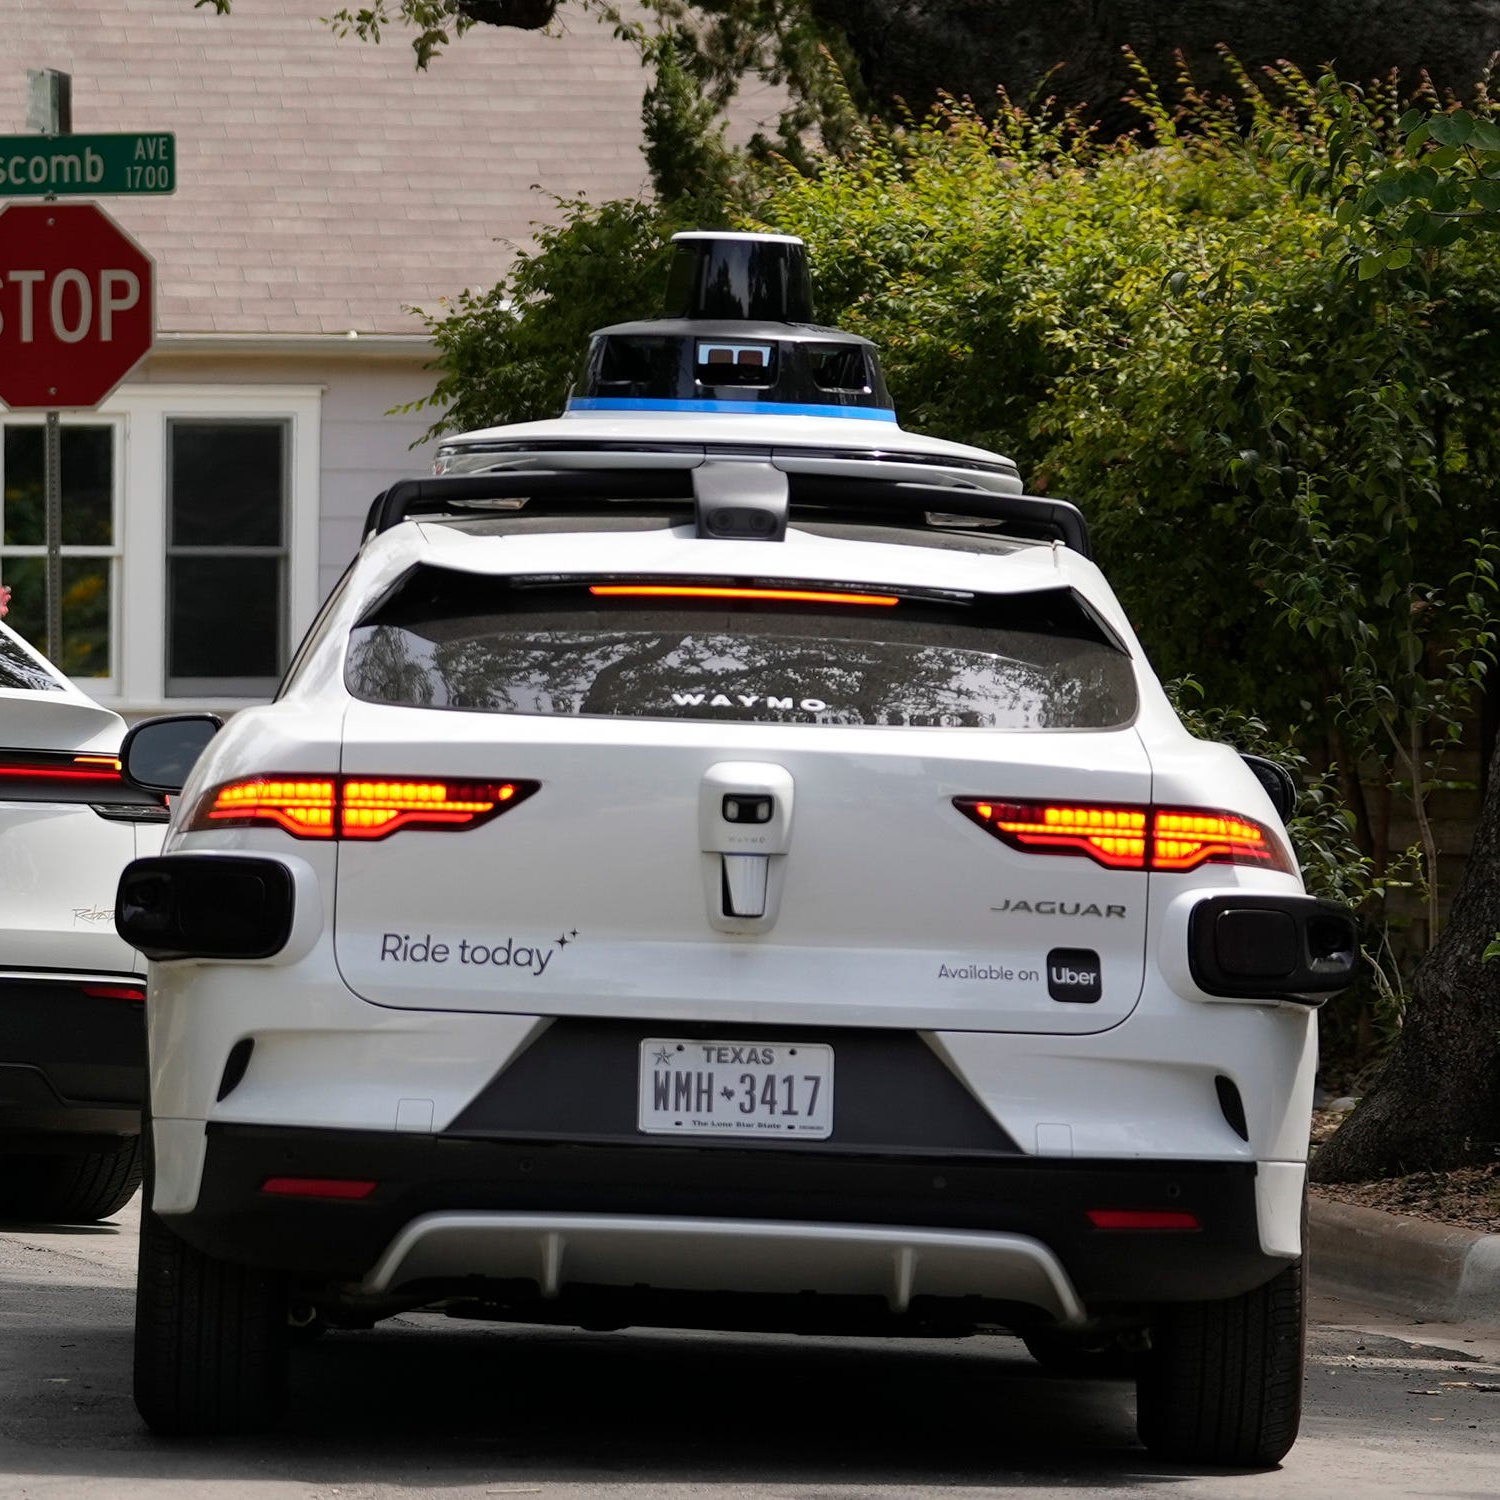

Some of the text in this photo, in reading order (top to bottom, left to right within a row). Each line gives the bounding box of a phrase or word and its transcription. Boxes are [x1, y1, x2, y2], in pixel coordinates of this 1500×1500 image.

[134, 137, 169, 161] AVE
[126, 166, 169, 189] 1700
[671, 693, 826, 711] WAYMO
[990, 899, 1126, 918] JAGUAR
[381, 933, 553, 976] Ride today
[938, 963, 1097, 986] Available on Uber
[702, 1046, 775, 1065] TEXAS
